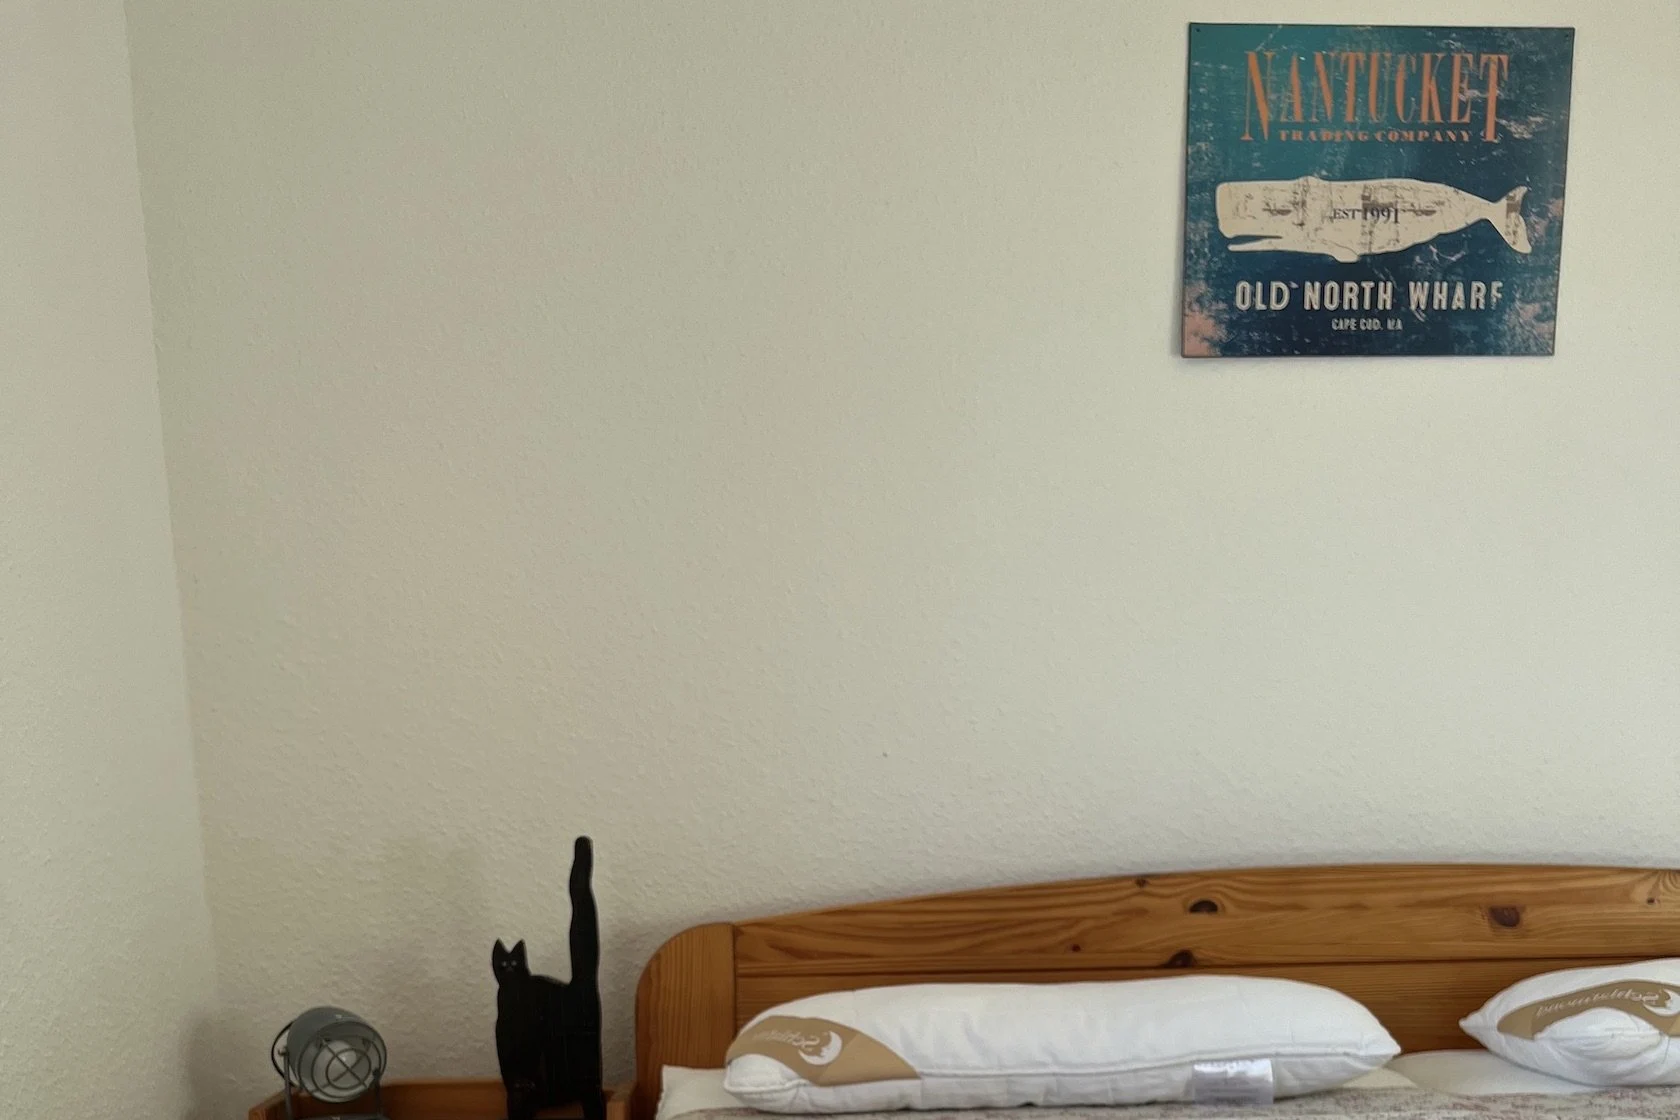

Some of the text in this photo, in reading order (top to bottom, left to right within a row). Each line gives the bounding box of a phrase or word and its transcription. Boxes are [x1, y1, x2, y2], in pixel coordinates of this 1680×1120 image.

[1240, 51, 1509, 142] NANTUCKET
[1279, 129, 1473, 143] TRADING COMPANY
[1333, 207, 1400, 225] EST 1991
[1235, 280, 1504, 311] OLD NORTH WHARF
[1331, 317, 1357, 331] CAPE
